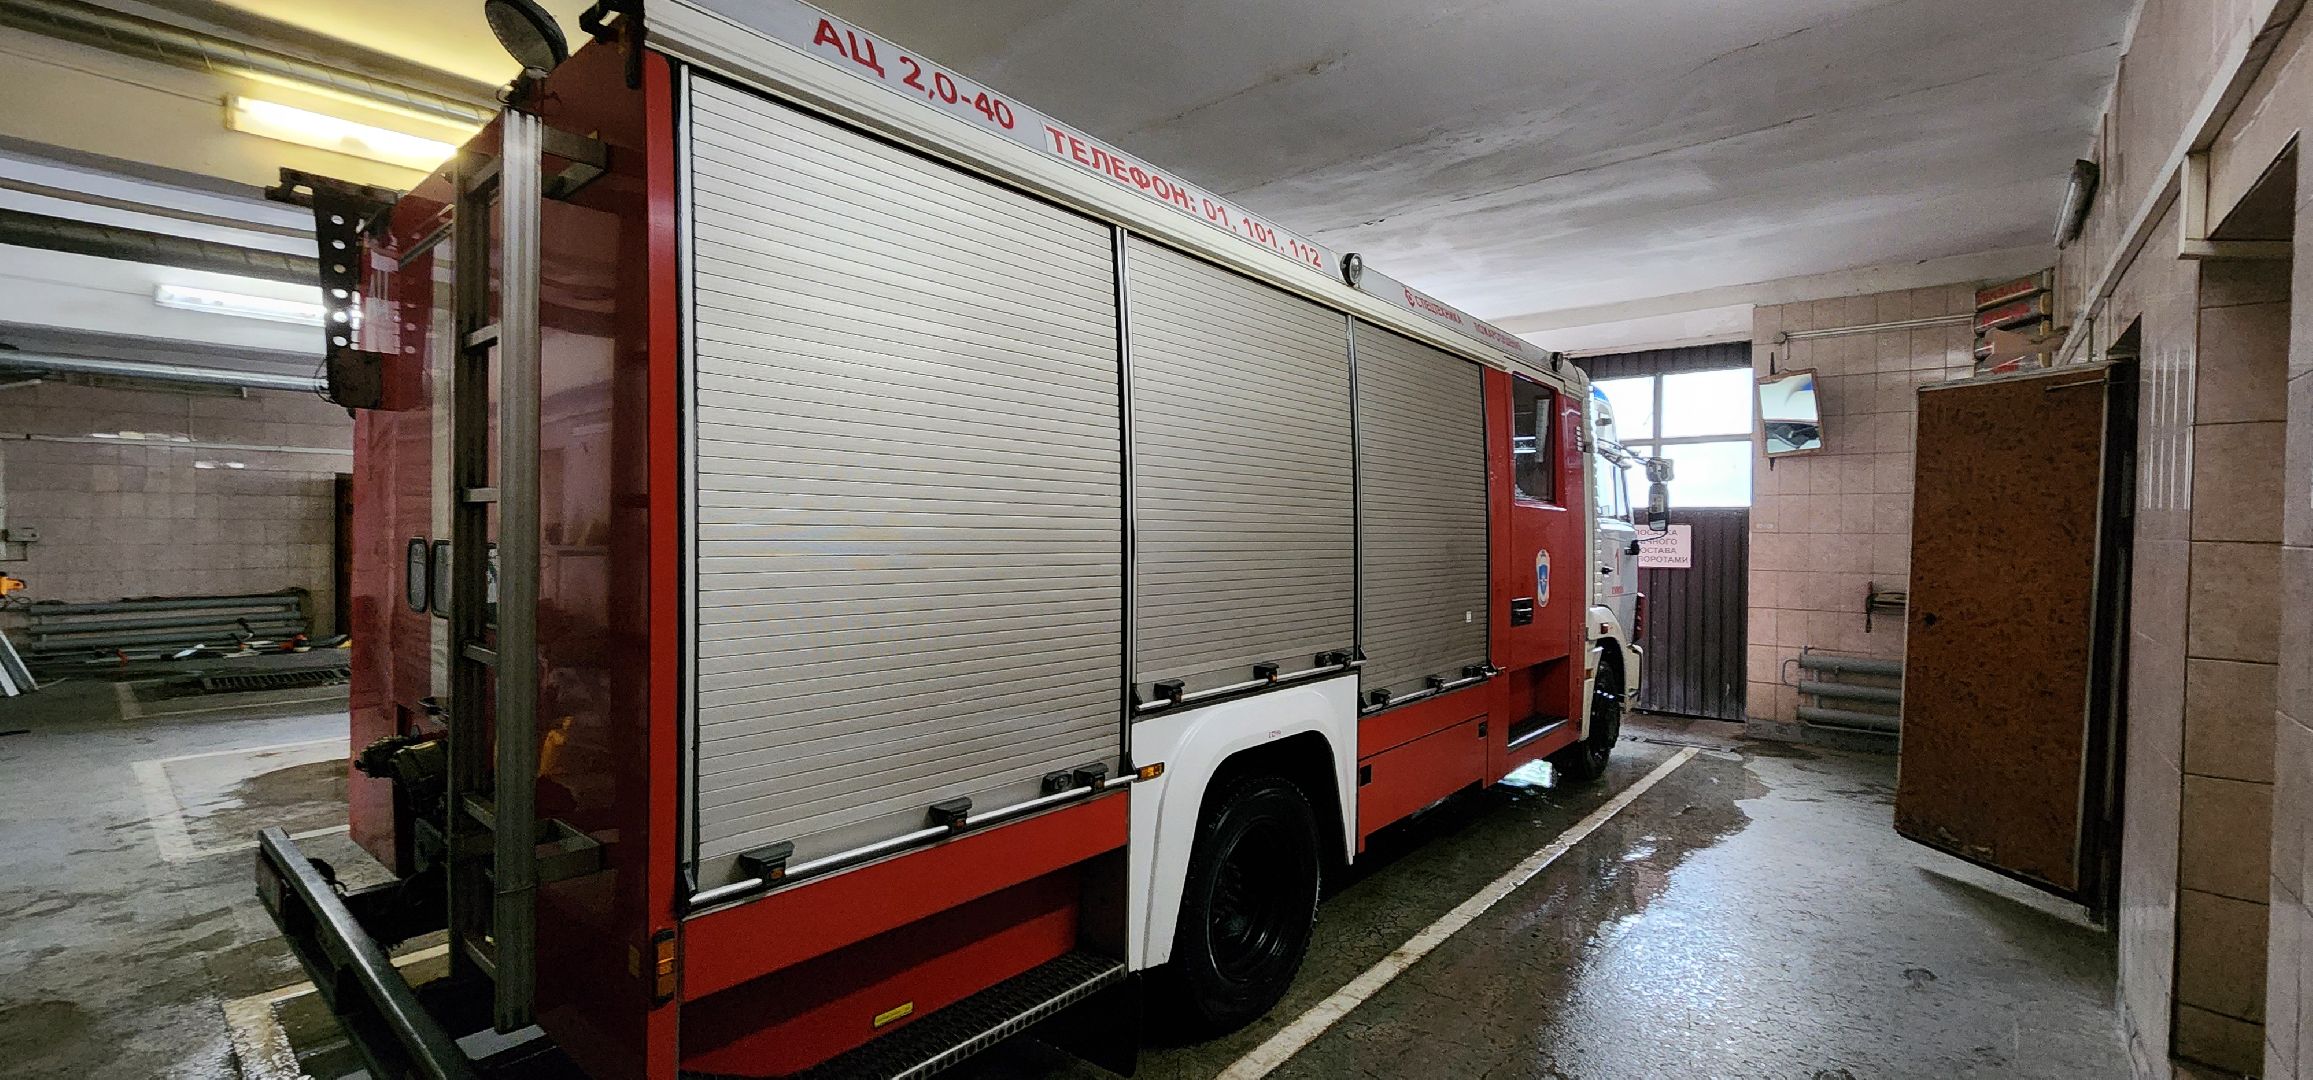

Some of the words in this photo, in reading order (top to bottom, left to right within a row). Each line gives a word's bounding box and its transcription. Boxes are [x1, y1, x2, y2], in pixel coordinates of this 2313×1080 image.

[812, 18, 886, 80] АЦ
[899, 55, 1015, 130] 2,0-40
[1045, 124, 1197, 213] ТЕЛЕФОН:
[1242, 216, 1285, 254] 101,
[1289, 238, 1322, 269] 112
